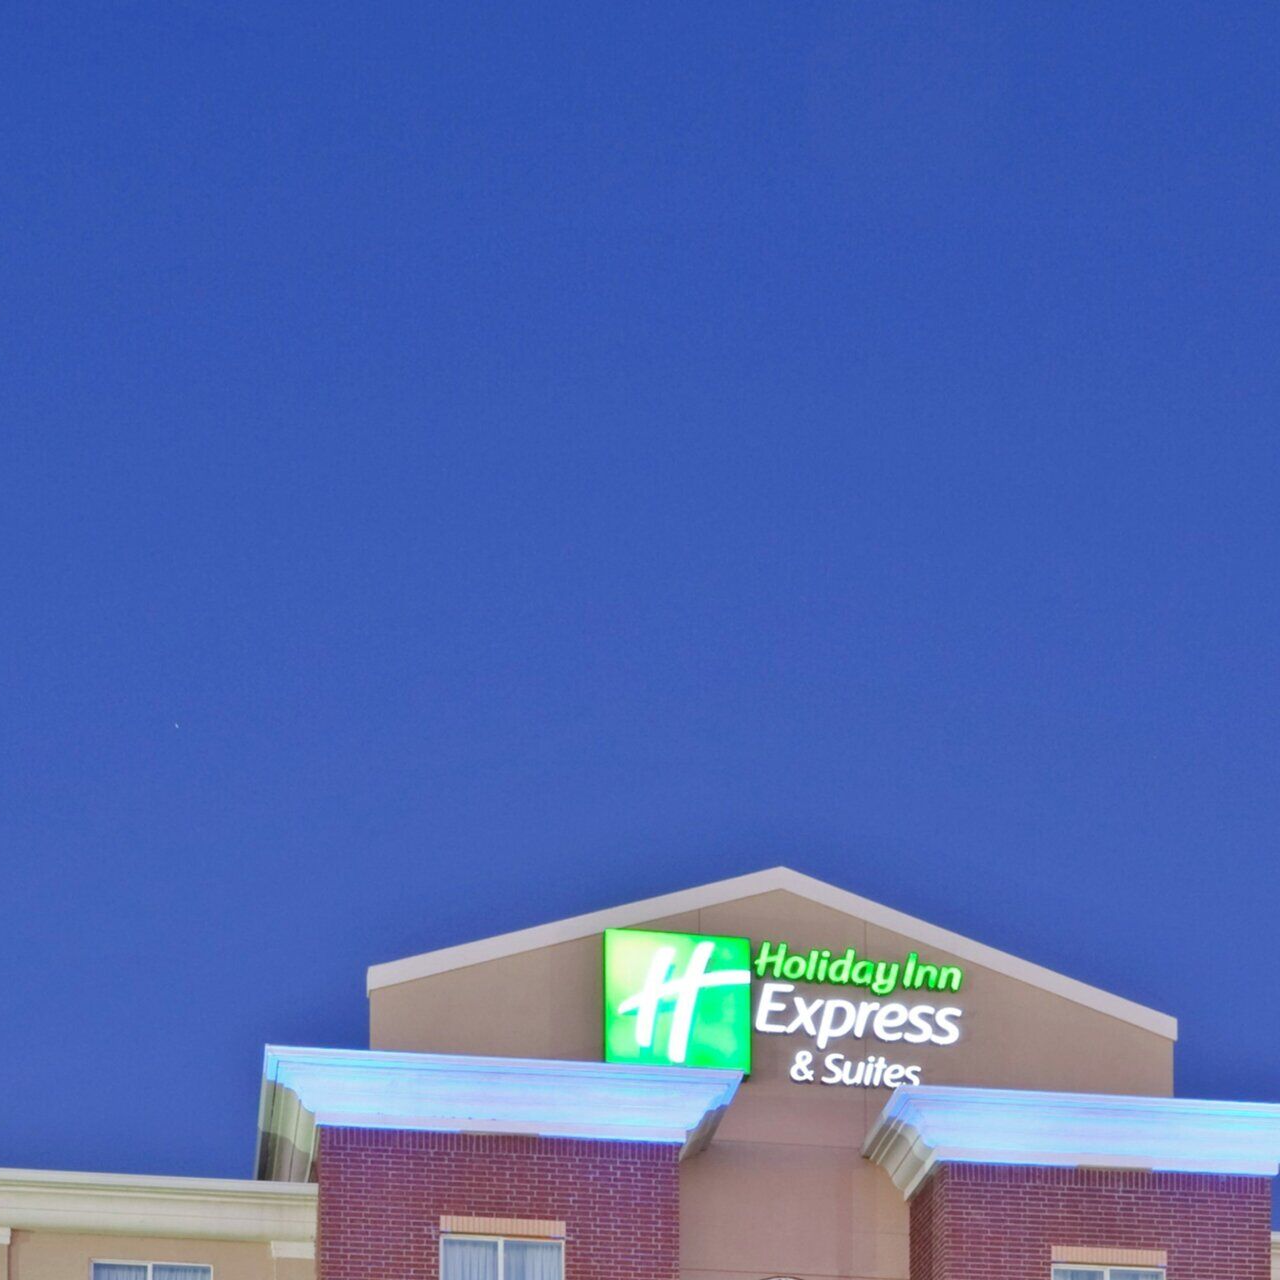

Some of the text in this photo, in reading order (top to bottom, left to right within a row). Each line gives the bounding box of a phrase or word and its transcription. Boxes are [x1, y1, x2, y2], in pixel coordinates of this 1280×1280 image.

[754, 941, 963, 995] Holiday Inn
[754, 982, 963, 1049] Express
[789, 1050, 922, 1088] & Suites
